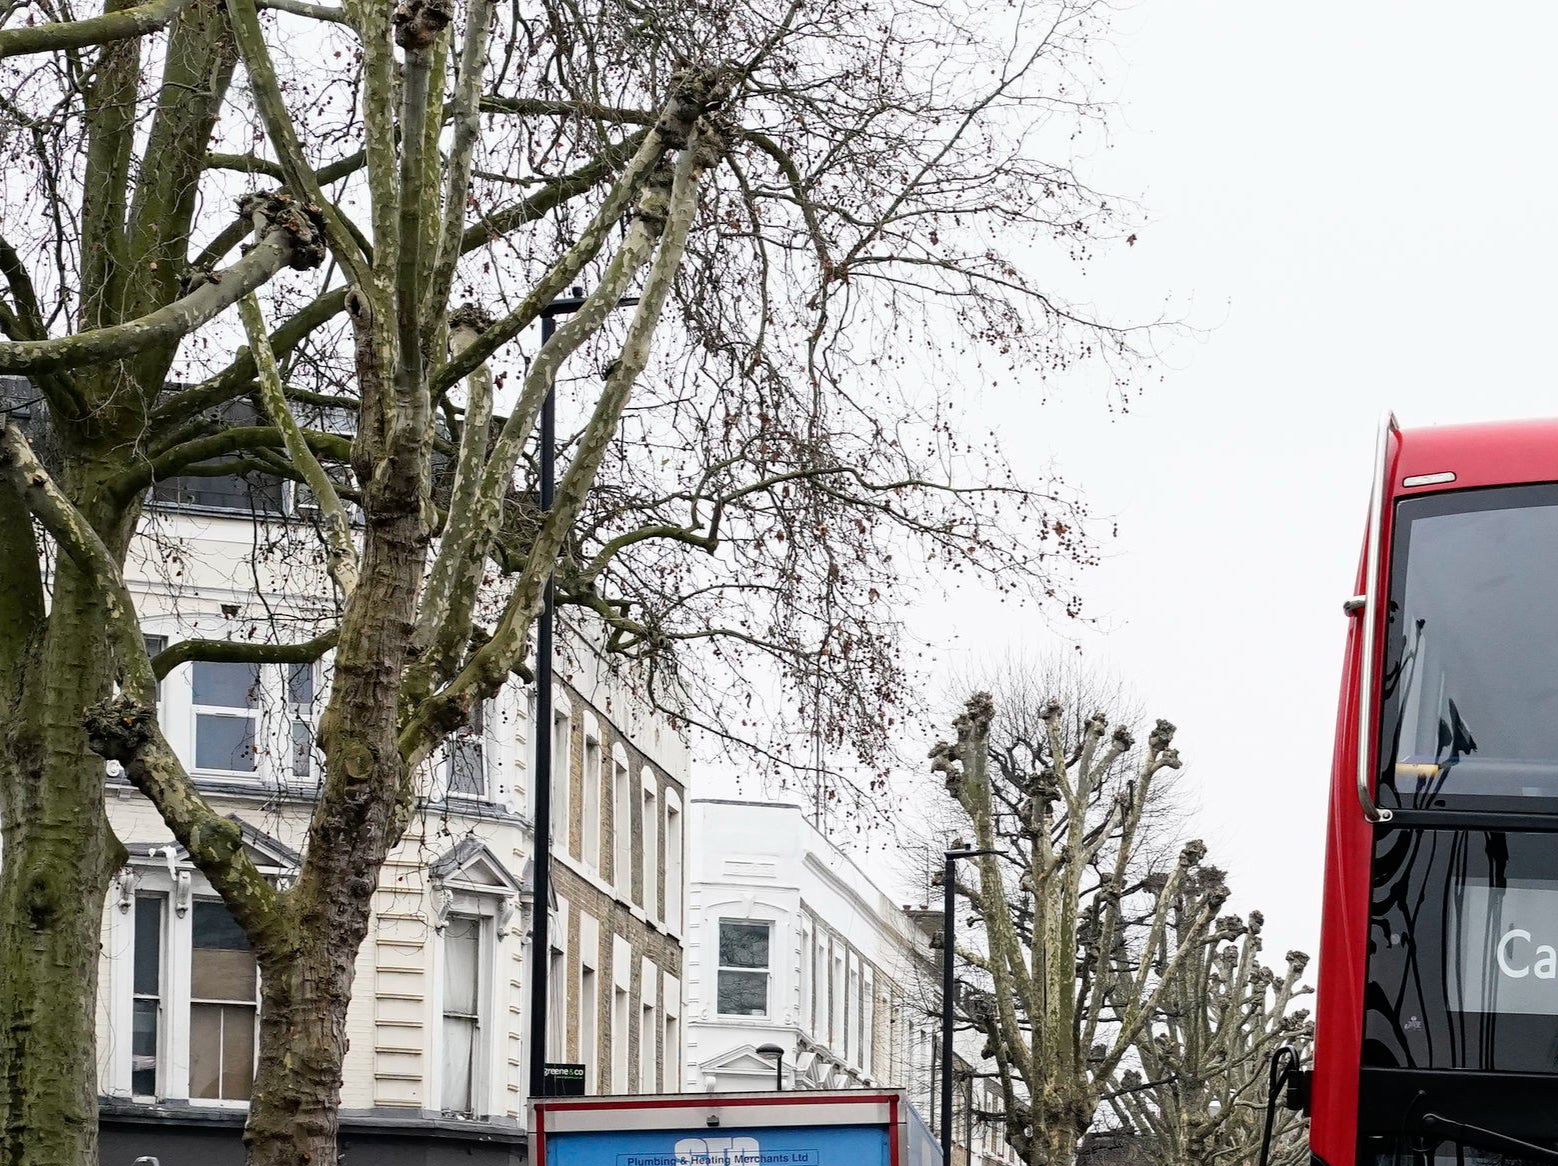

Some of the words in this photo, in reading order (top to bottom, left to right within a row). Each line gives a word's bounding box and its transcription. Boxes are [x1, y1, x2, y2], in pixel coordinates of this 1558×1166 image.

[680, 1156, 688, 1166] &
[691, 1155, 731, 1166] Heating
[734, 1154, 789, 1164] Merchants
[792, 1152, 808, 1163] Ltd
